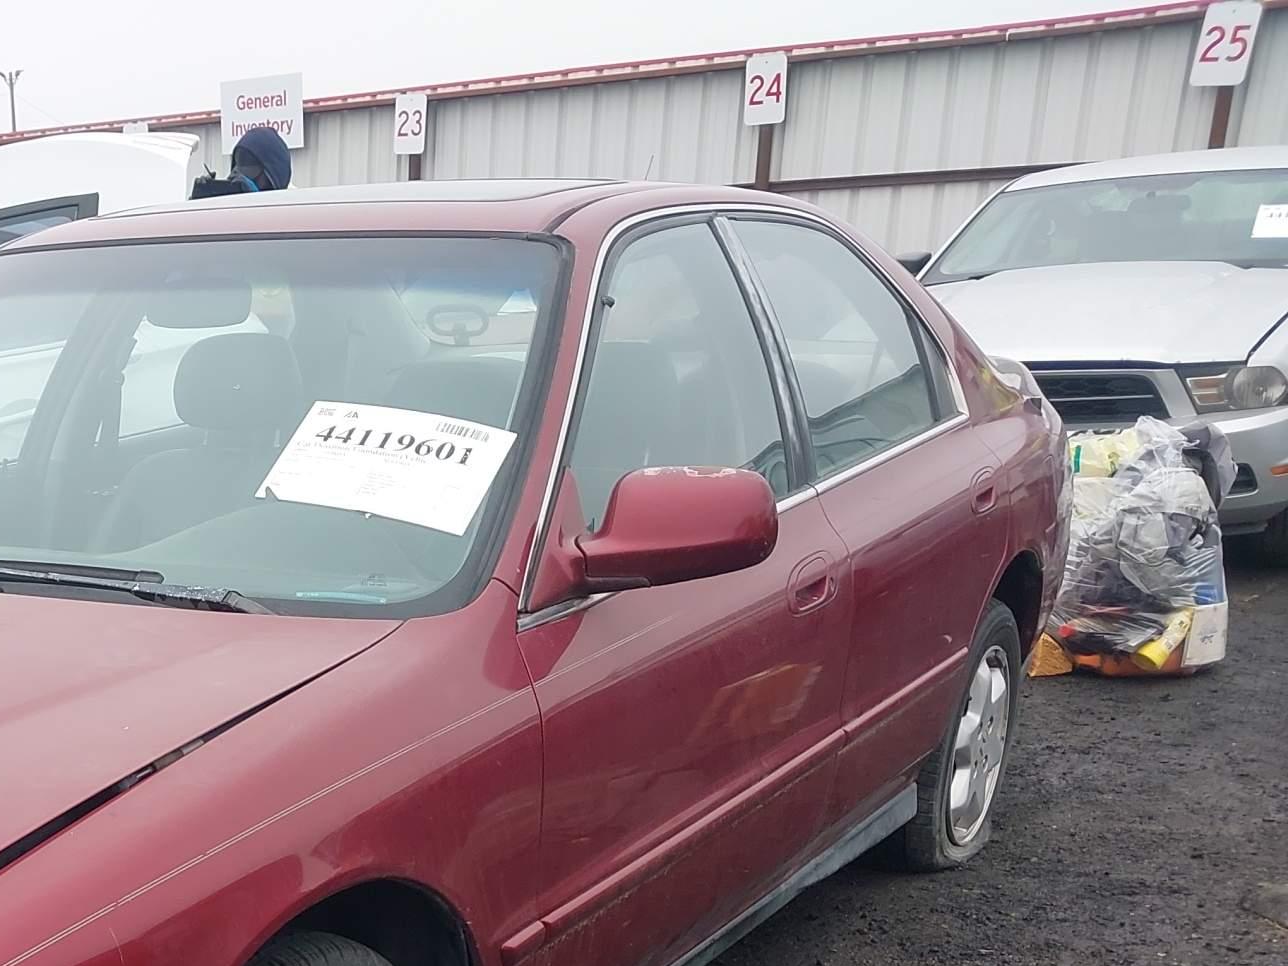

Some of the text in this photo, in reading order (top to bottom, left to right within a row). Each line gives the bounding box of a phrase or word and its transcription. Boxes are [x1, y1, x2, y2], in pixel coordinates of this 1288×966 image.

[1199, 25, 1252, 63] 25
[236, 89, 287, 111] General
[749, 72, 782, 106] 24
[397, 110, 422, 137] 23
[315, 425, 473, 466] 44119601
